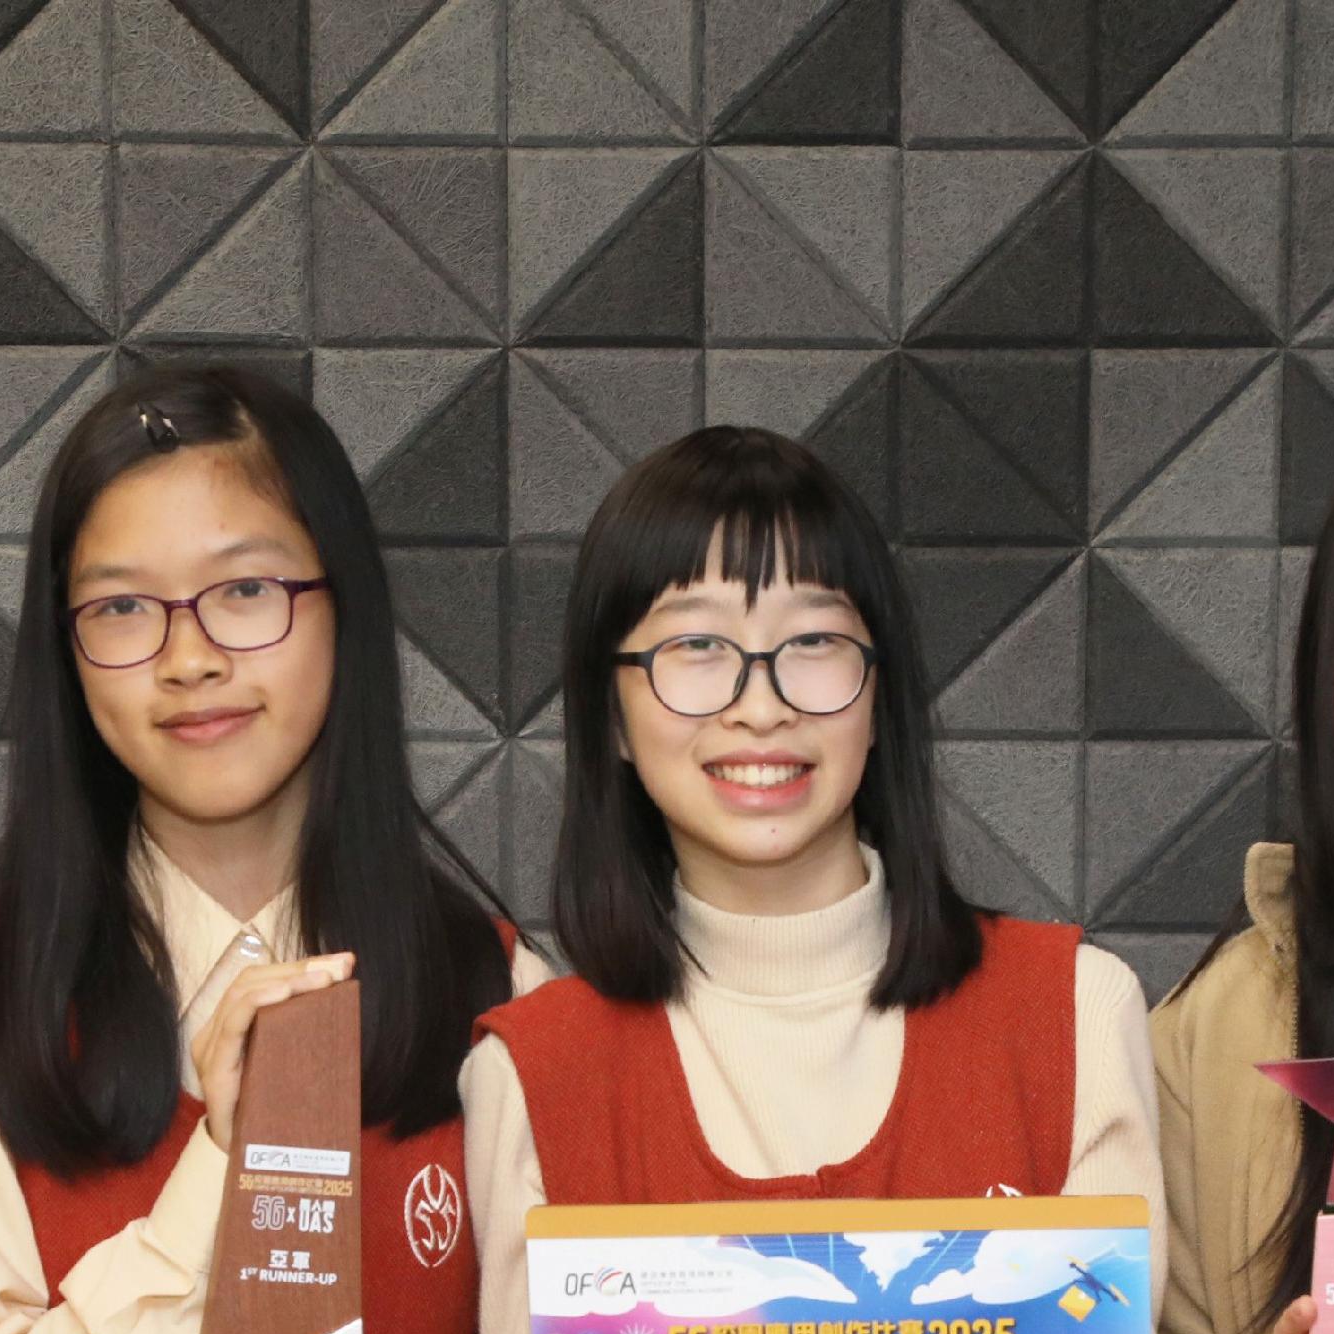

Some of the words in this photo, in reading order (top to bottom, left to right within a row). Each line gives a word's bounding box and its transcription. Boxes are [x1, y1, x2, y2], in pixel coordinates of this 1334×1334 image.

[323, 1179, 353, 1196] 2025
[298, 1210, 334, 1233] UAS
[259, 1269, 337, 1285] RUNNER-UP
